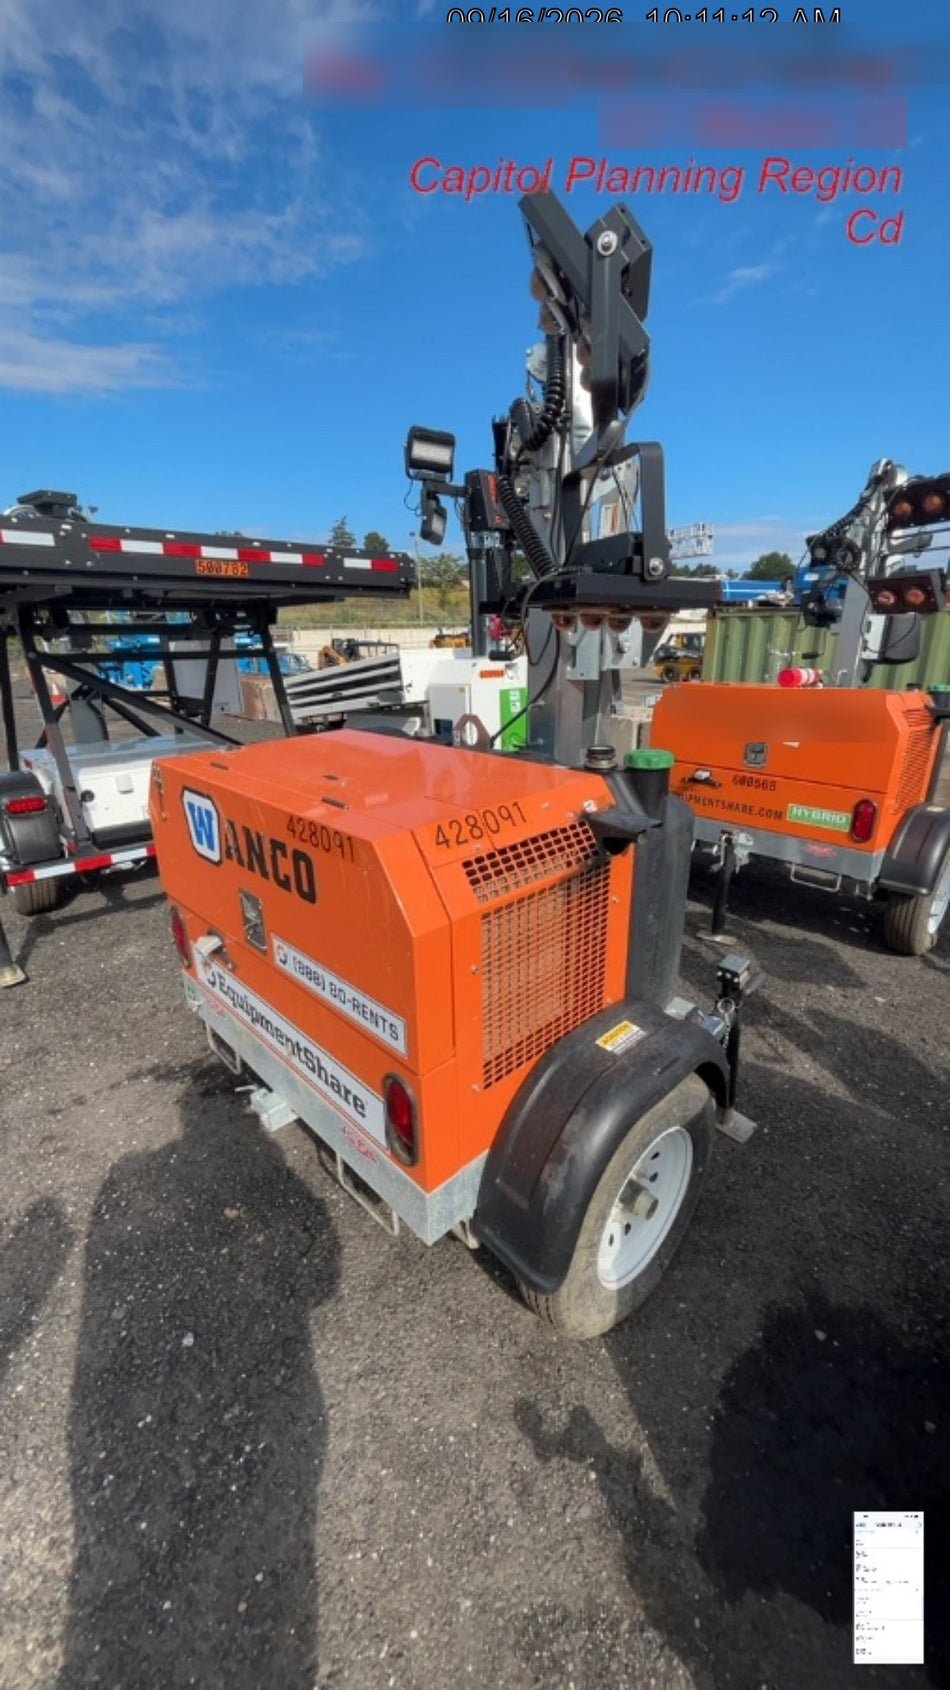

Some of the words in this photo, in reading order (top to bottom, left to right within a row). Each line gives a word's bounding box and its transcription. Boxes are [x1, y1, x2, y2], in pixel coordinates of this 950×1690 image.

[287, 814, 355, 863] 428091
[435, 801, 527, 849] 428091
[791, 805, 847, 824] HYBRID
[186, 799, 317, 904] WANCO
[292, 956, 326, 992] (888)
[329, 981, 400, 1042] 80-RENTS
[217, 971, 367, 1119] EquipmentShare
